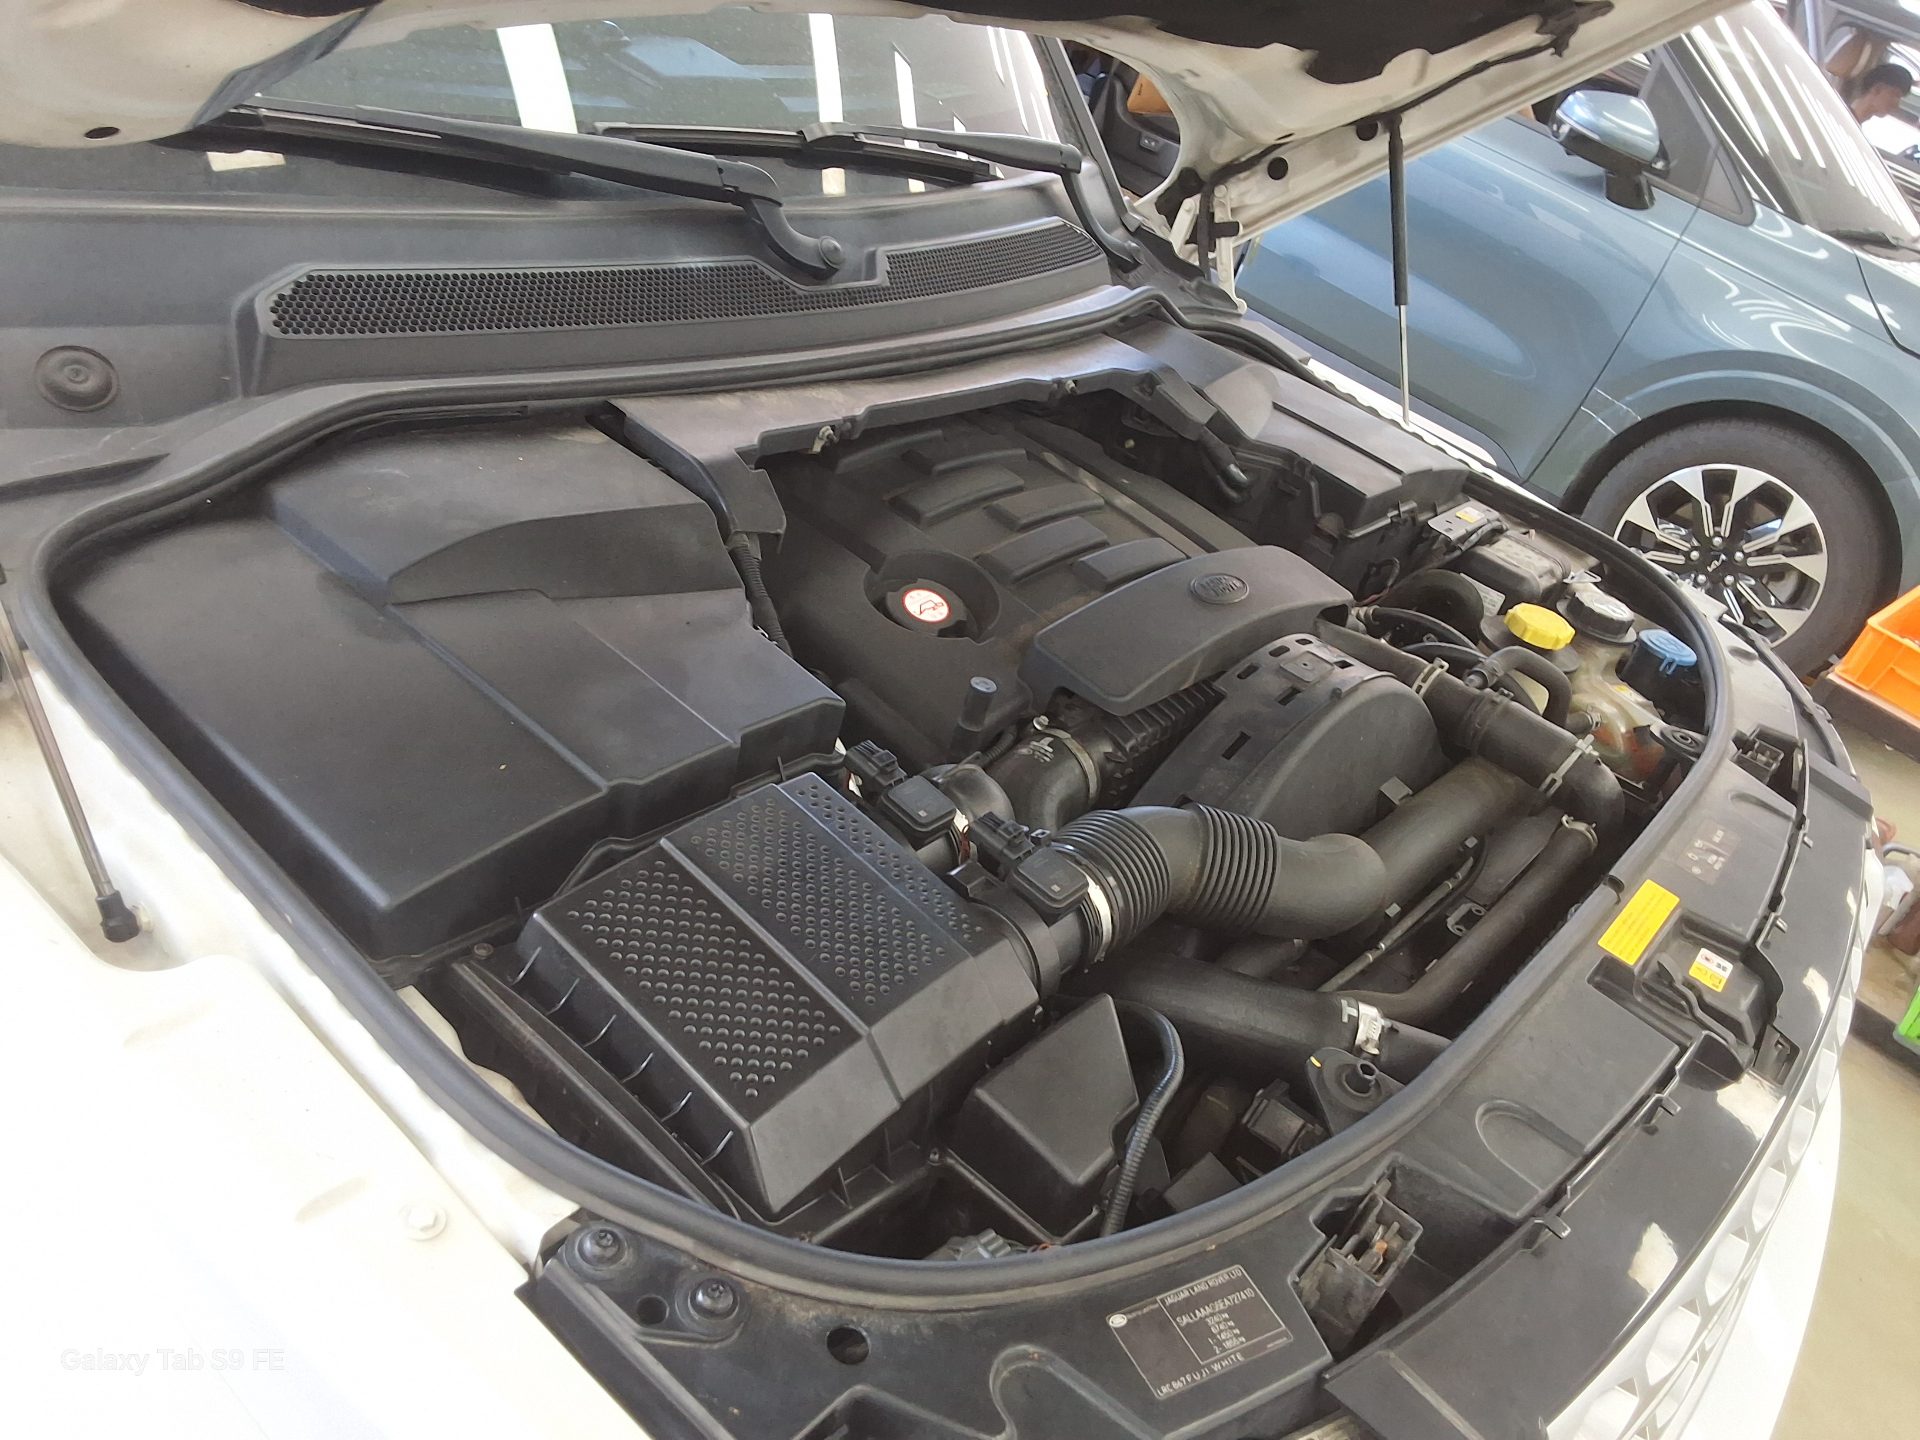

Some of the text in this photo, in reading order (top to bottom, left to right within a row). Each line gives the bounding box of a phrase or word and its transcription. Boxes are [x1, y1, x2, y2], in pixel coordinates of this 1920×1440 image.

[1164, 1268, 1242, 1306] JAGUAR LAND ROVER LTD
[1211, 1352, 1244, 1372] WHITE
